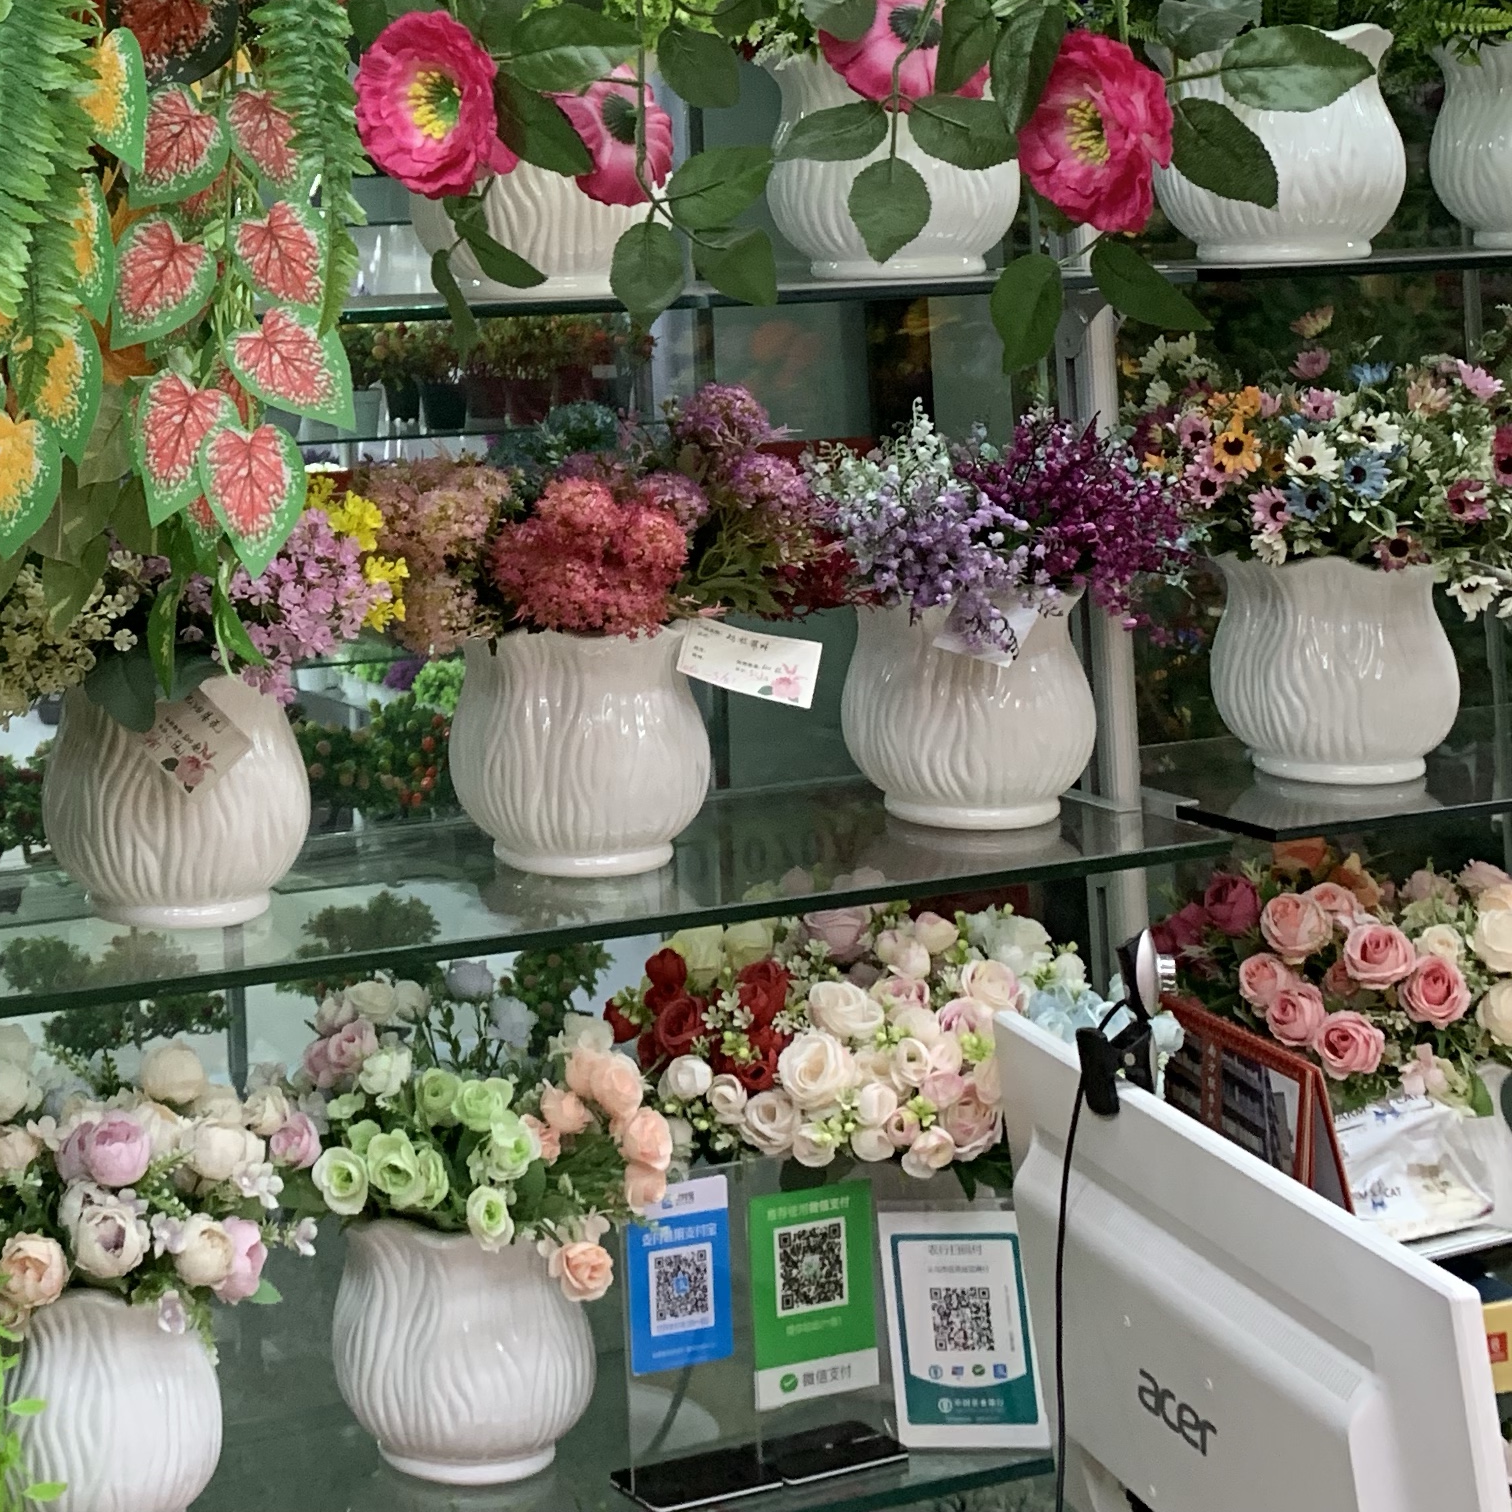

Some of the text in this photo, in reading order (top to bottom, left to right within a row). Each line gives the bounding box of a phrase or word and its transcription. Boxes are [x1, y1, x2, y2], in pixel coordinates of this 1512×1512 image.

[802, 1364, 852, 1387] 微信支付
[1138, 1368, 1217, 1456] acer
